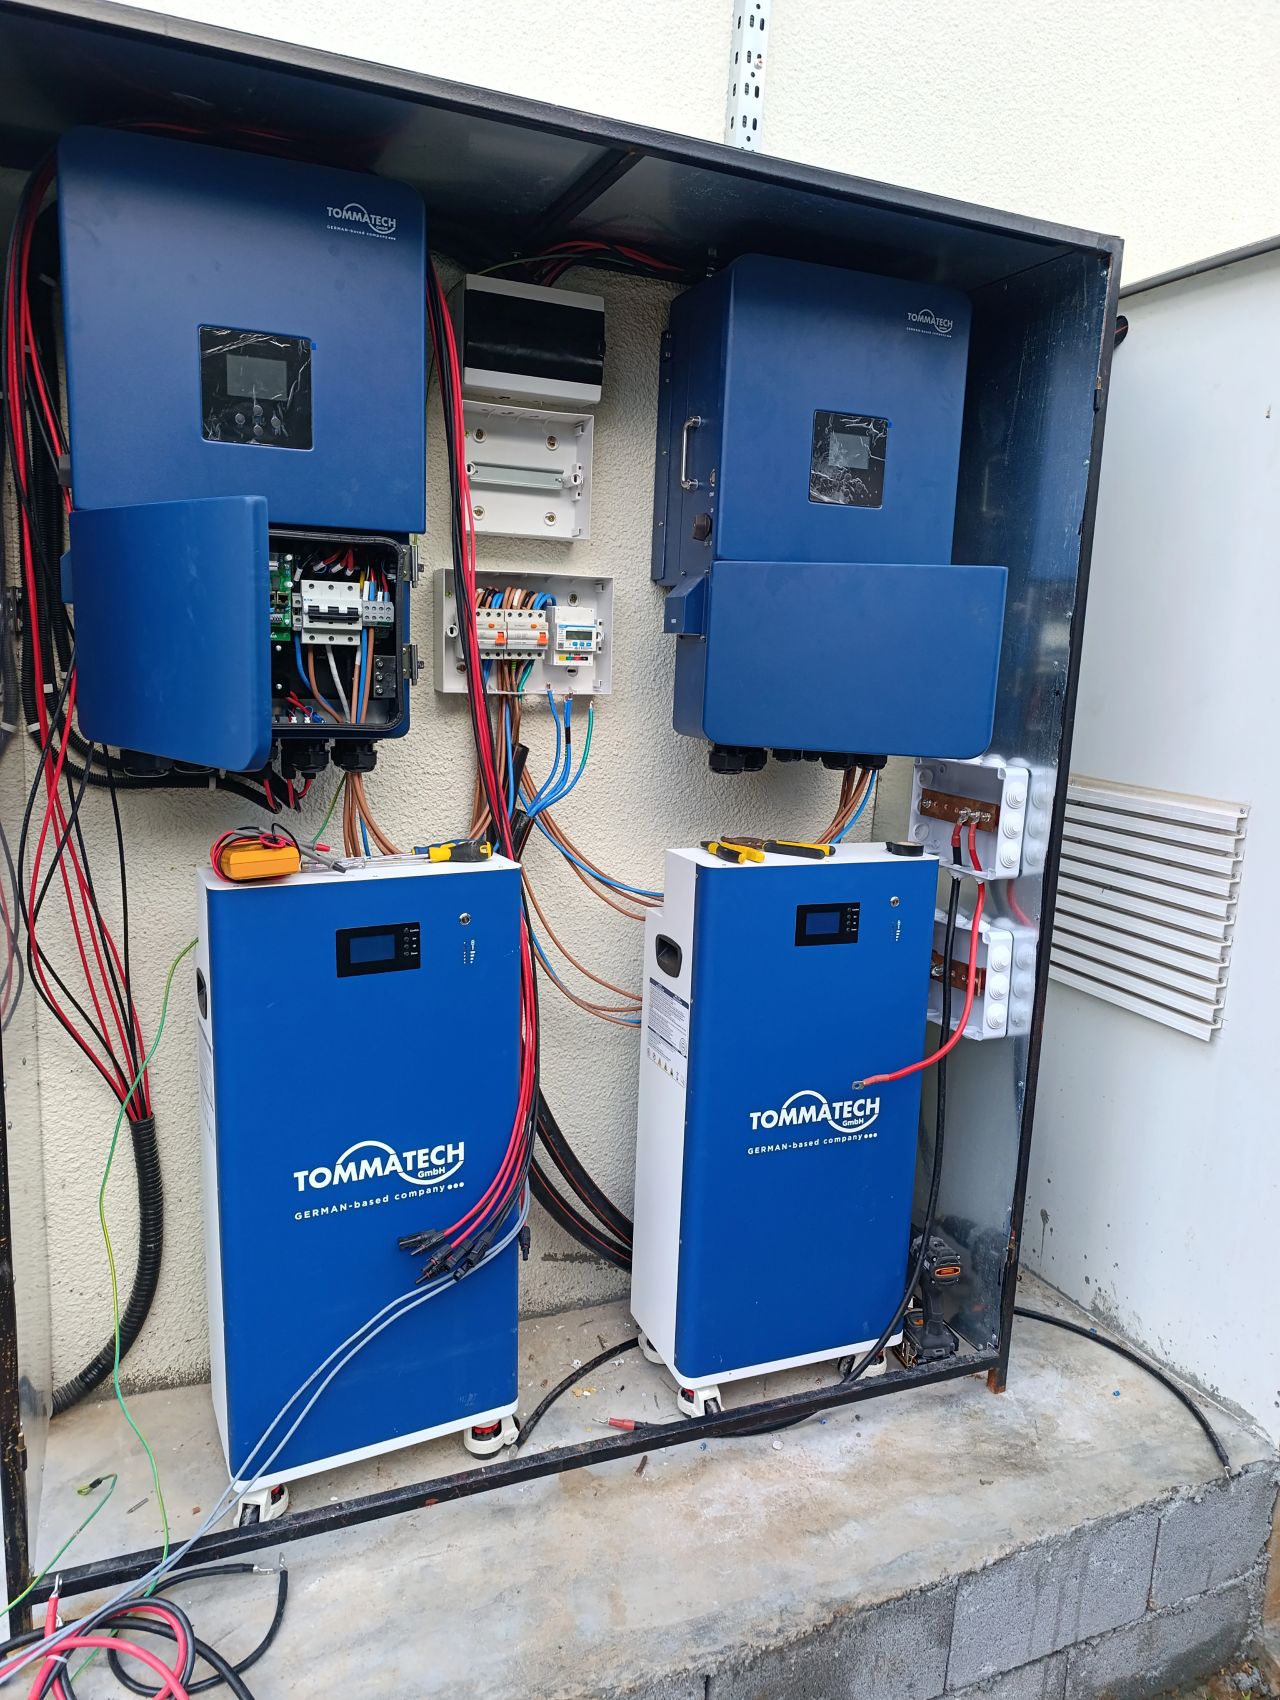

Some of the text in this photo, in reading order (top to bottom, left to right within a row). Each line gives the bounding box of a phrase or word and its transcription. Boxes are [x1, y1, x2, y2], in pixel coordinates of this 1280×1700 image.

[326, 206, 397, 228] TOMMATECH
[907, 312, 953, 328] TOMMATECH
[749, 1097, 880, 1130] TOMMATECH
[842, 1118, 864, 1127] GmbH
[747, 1139, 820, 1155] GERMAN-based
[293, 1141, 465, 1192] TOMMATECH
[417, 1166, 446, 1178] GmbH
[294, 1194, 389, 1221] GERMAN-based
